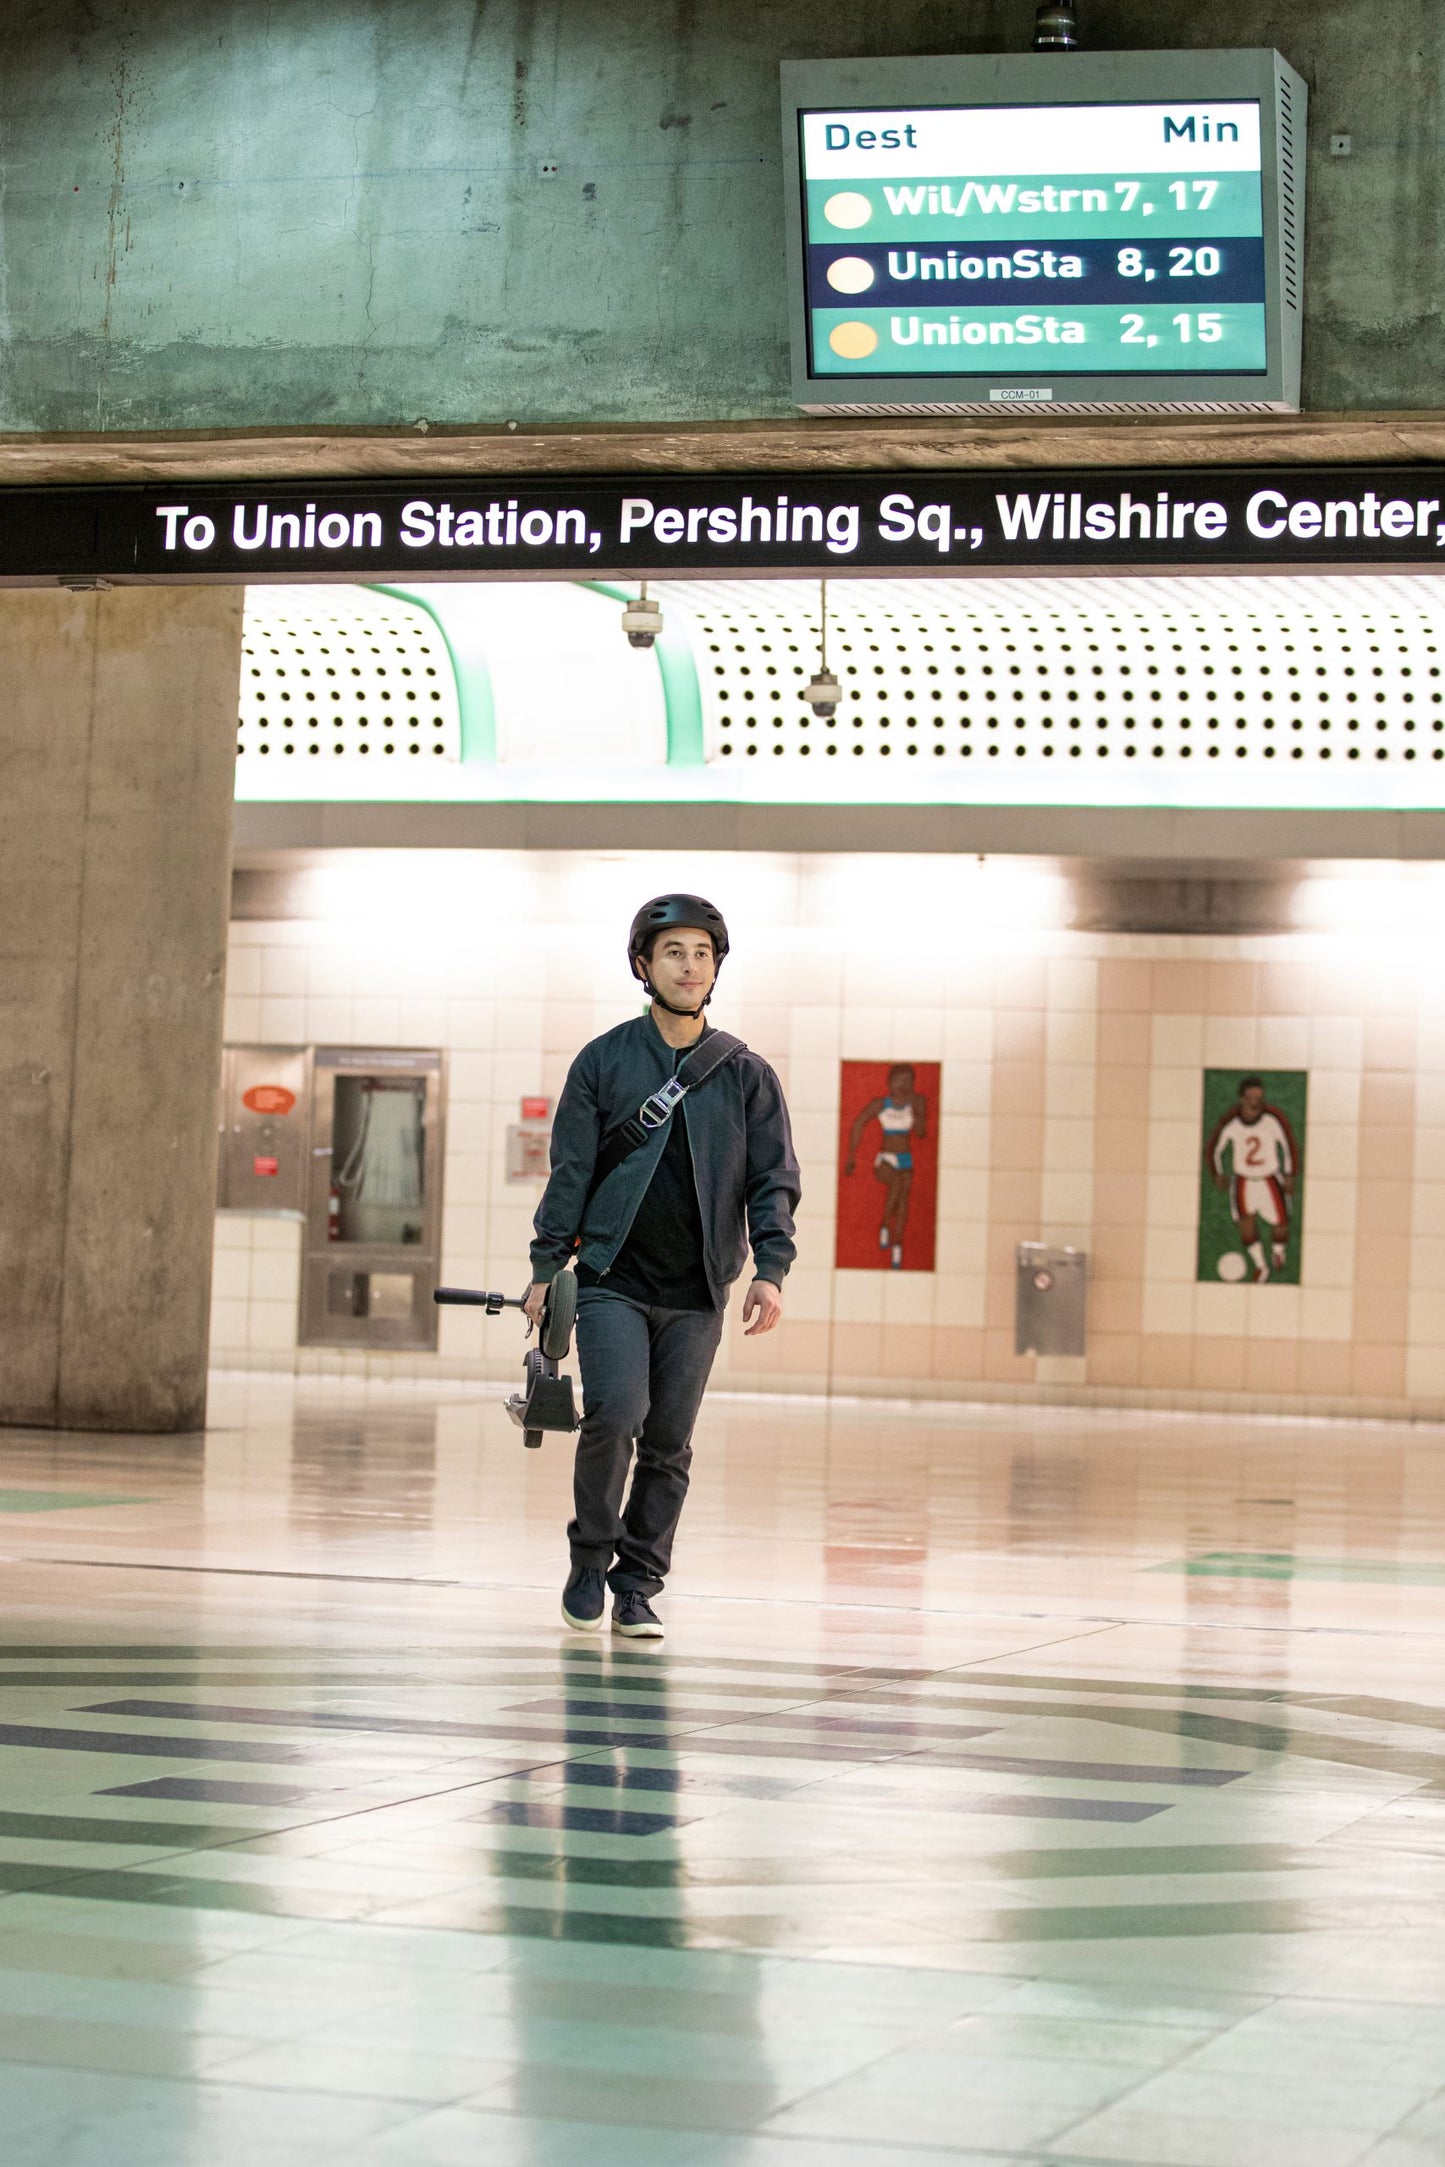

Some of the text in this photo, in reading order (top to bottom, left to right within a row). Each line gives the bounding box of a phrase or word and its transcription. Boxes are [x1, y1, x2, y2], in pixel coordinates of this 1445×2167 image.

[825, 115, 1238, 151] Dest Min
[882, 180, 1219, 217] Wil/Wstrn 7, 17
[888, 246, 1221, 282] UnionSta 8, 20
[890, 312, 1223, 349] UnionSta 2, 15
[1000, 390, 1040, 400] CCM-01
[156, 490, 1445, 555] To Union Station, Pershing Sq., Wilshire Center,
[1245, 1136, 1265, 1166] 2
